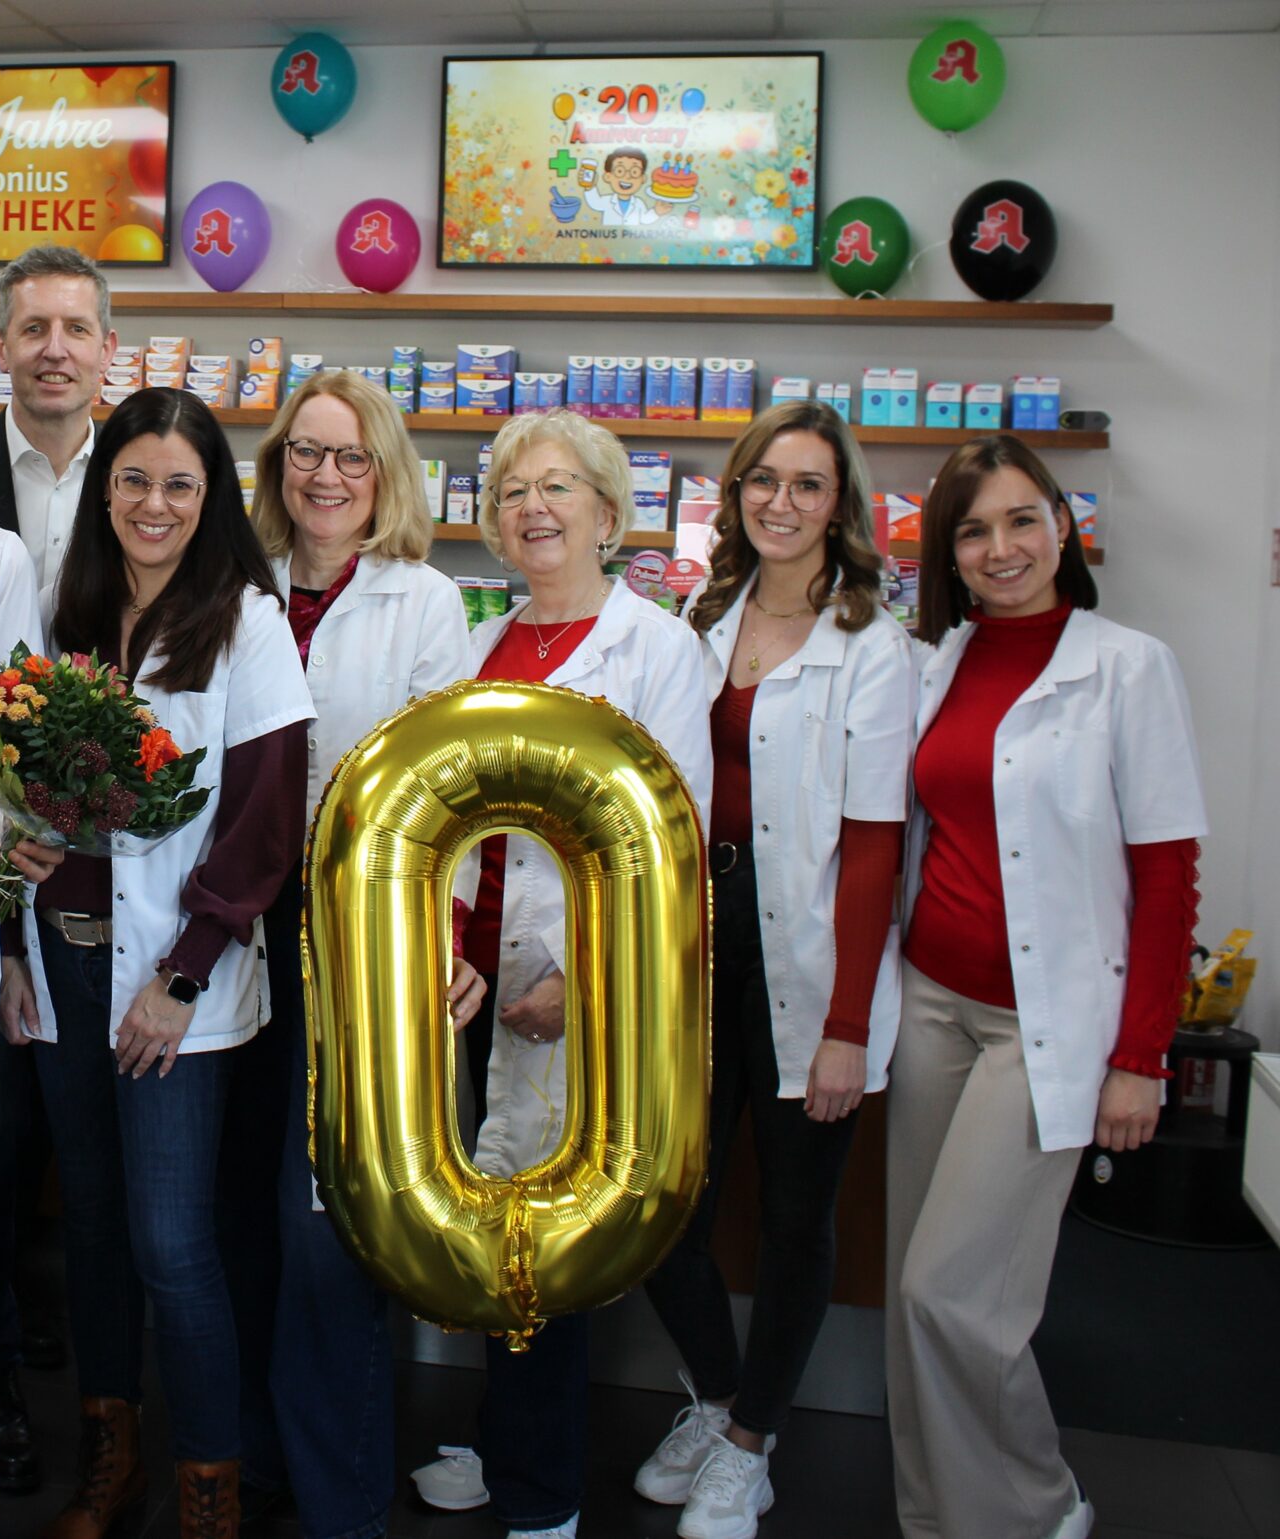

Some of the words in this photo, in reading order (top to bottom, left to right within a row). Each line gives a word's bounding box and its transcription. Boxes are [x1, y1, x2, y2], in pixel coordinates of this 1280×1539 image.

[570, 121, 689, 148] Anniversary
[556, 228, 618, 239] ANTONIUS
[631, 455, 648, 463] ACC
[450, 477, 471, 486] ACC
